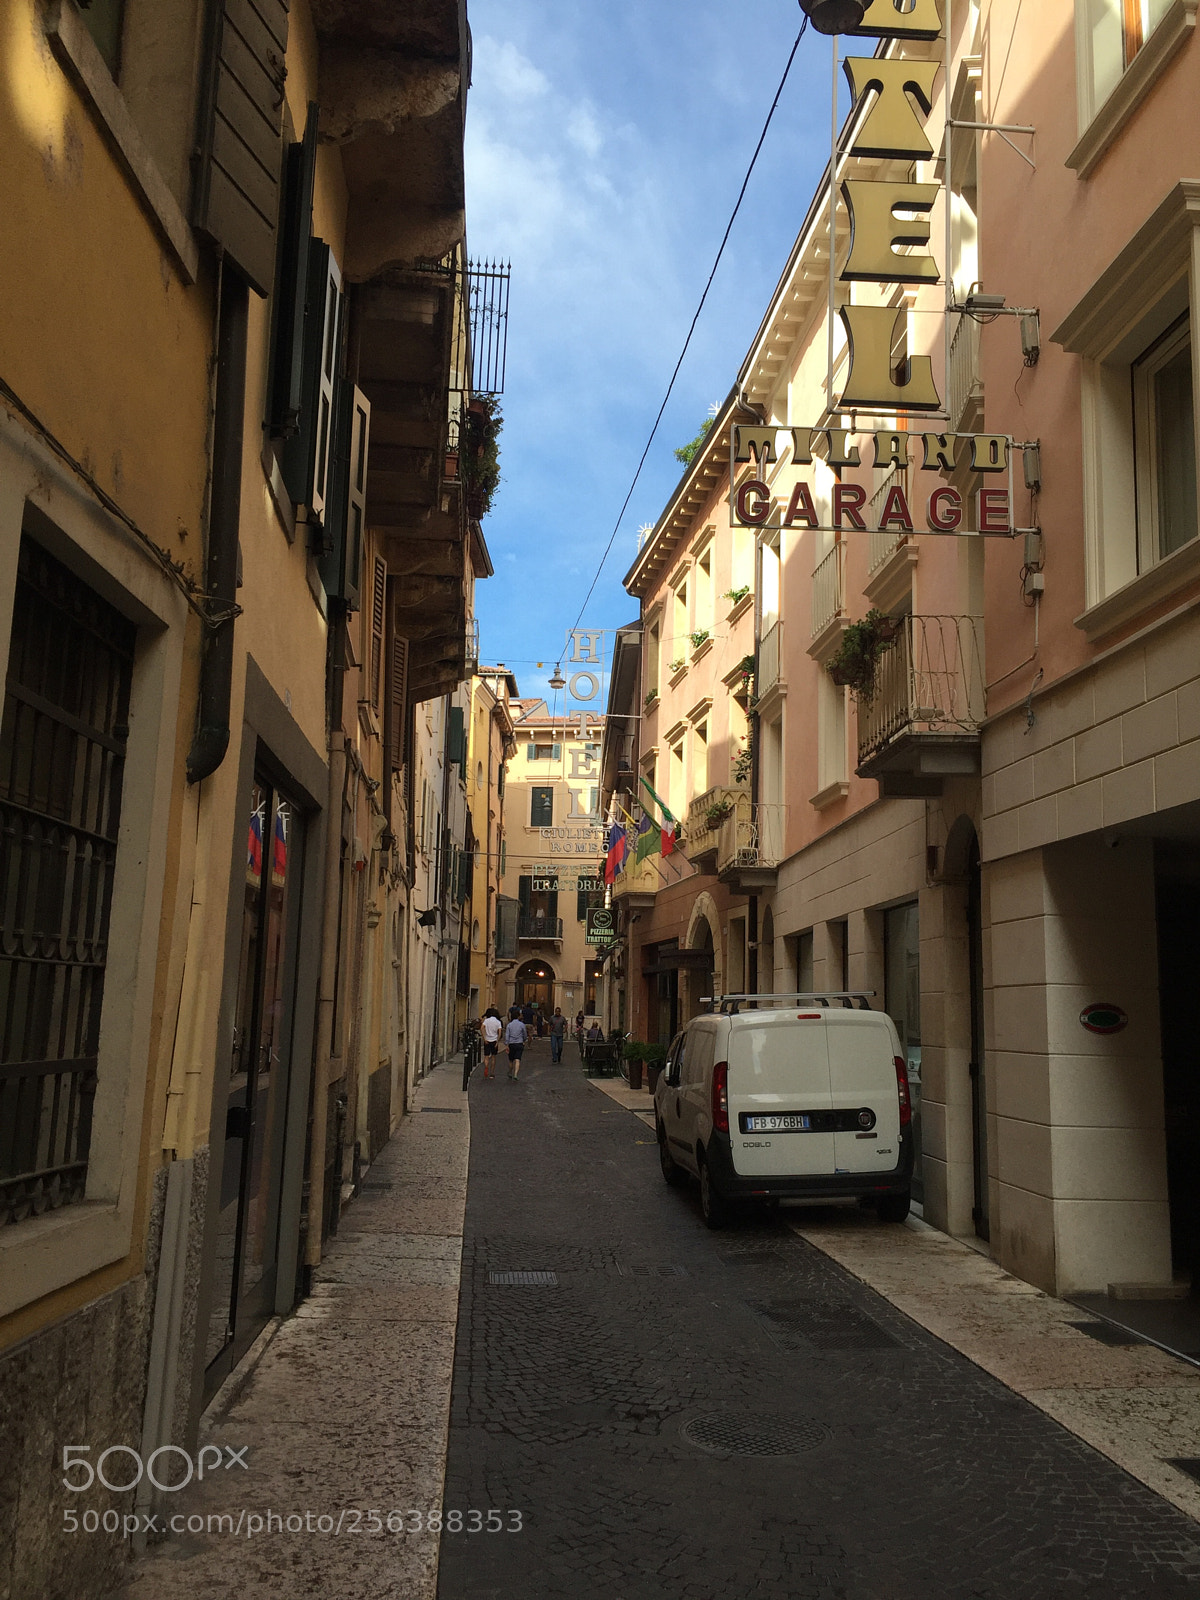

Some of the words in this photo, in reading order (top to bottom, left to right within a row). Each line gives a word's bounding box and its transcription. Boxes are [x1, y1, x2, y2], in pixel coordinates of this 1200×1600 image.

[735, 426, 1008, 472] MILANO
[735, 480, 1013, 533] GARAGE
[568, 633, 601, 819] HOTEL
[541, 828, 611, 839] GIULIETT
[550, 842, 610, 853] ROMEO
[534, 864, 598, 876] PIZZERI
[534, 879, 606, 891] TRATTORIA
[753, 1118, 767, 1129] FB
[770, 1116, 803, 1128] 976BH
